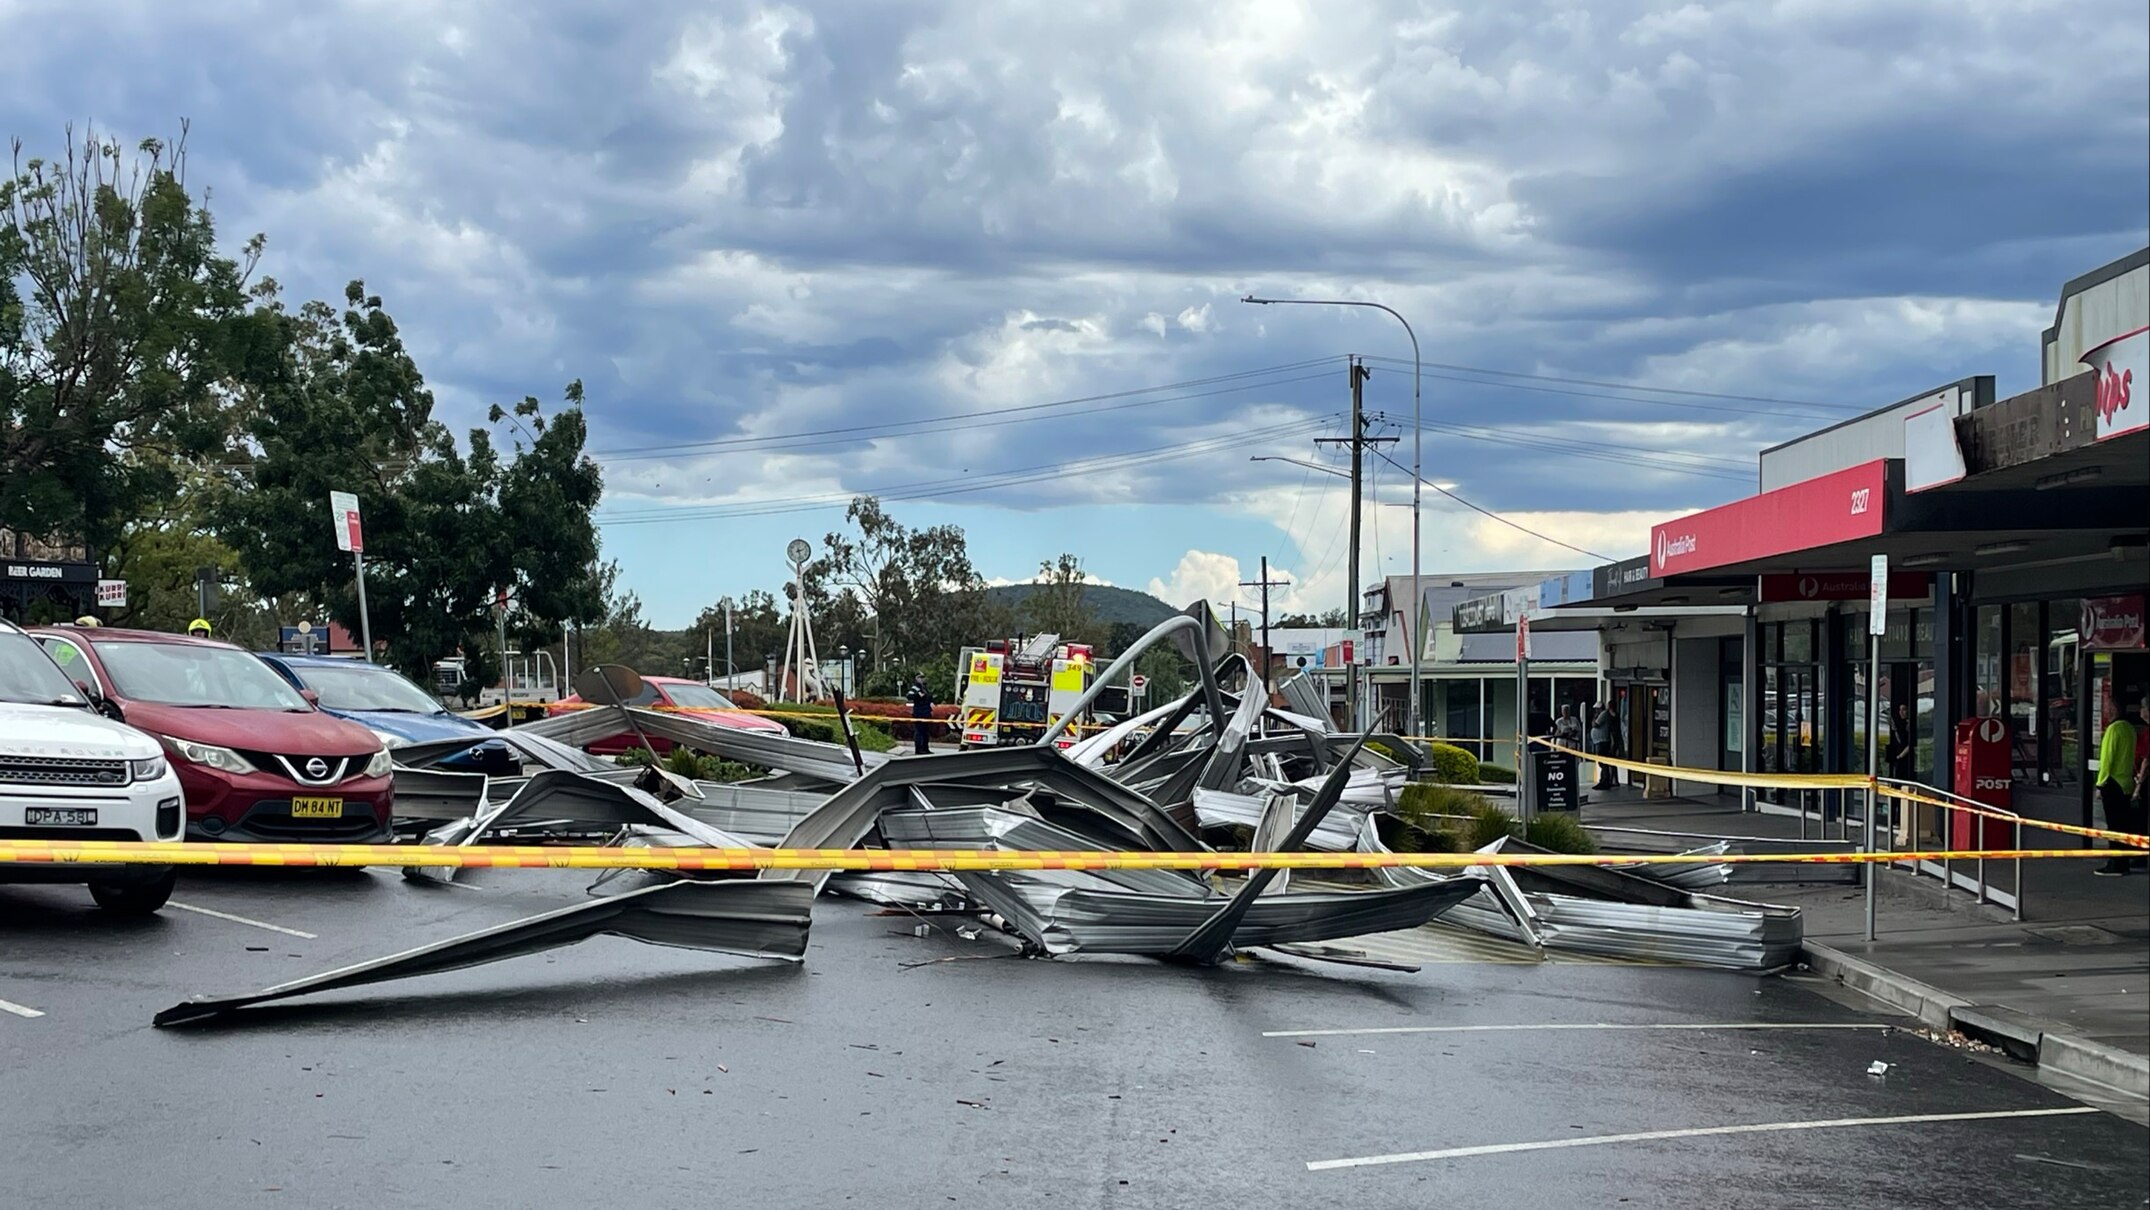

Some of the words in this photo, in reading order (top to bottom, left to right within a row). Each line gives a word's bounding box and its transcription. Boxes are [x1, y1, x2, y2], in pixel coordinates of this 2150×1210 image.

[1851, 488, 1870, 515] 2327
[1667, 536, 1686, 557] Australia
[1685, 533, 1696, 552] Post
[8, 566, 27, 577] BEER
[29, 567, 63, 578] GARDEN
[100, 584, 126, 593] KURRI
[1822, 581, 1867, 593] Australia
[100, 592, 126, 601] KURRI
[1067, 664, 1081, 672] 349
[1548, 772, 1564, 780] NO
[1975, 779, 2012, 789] POST
